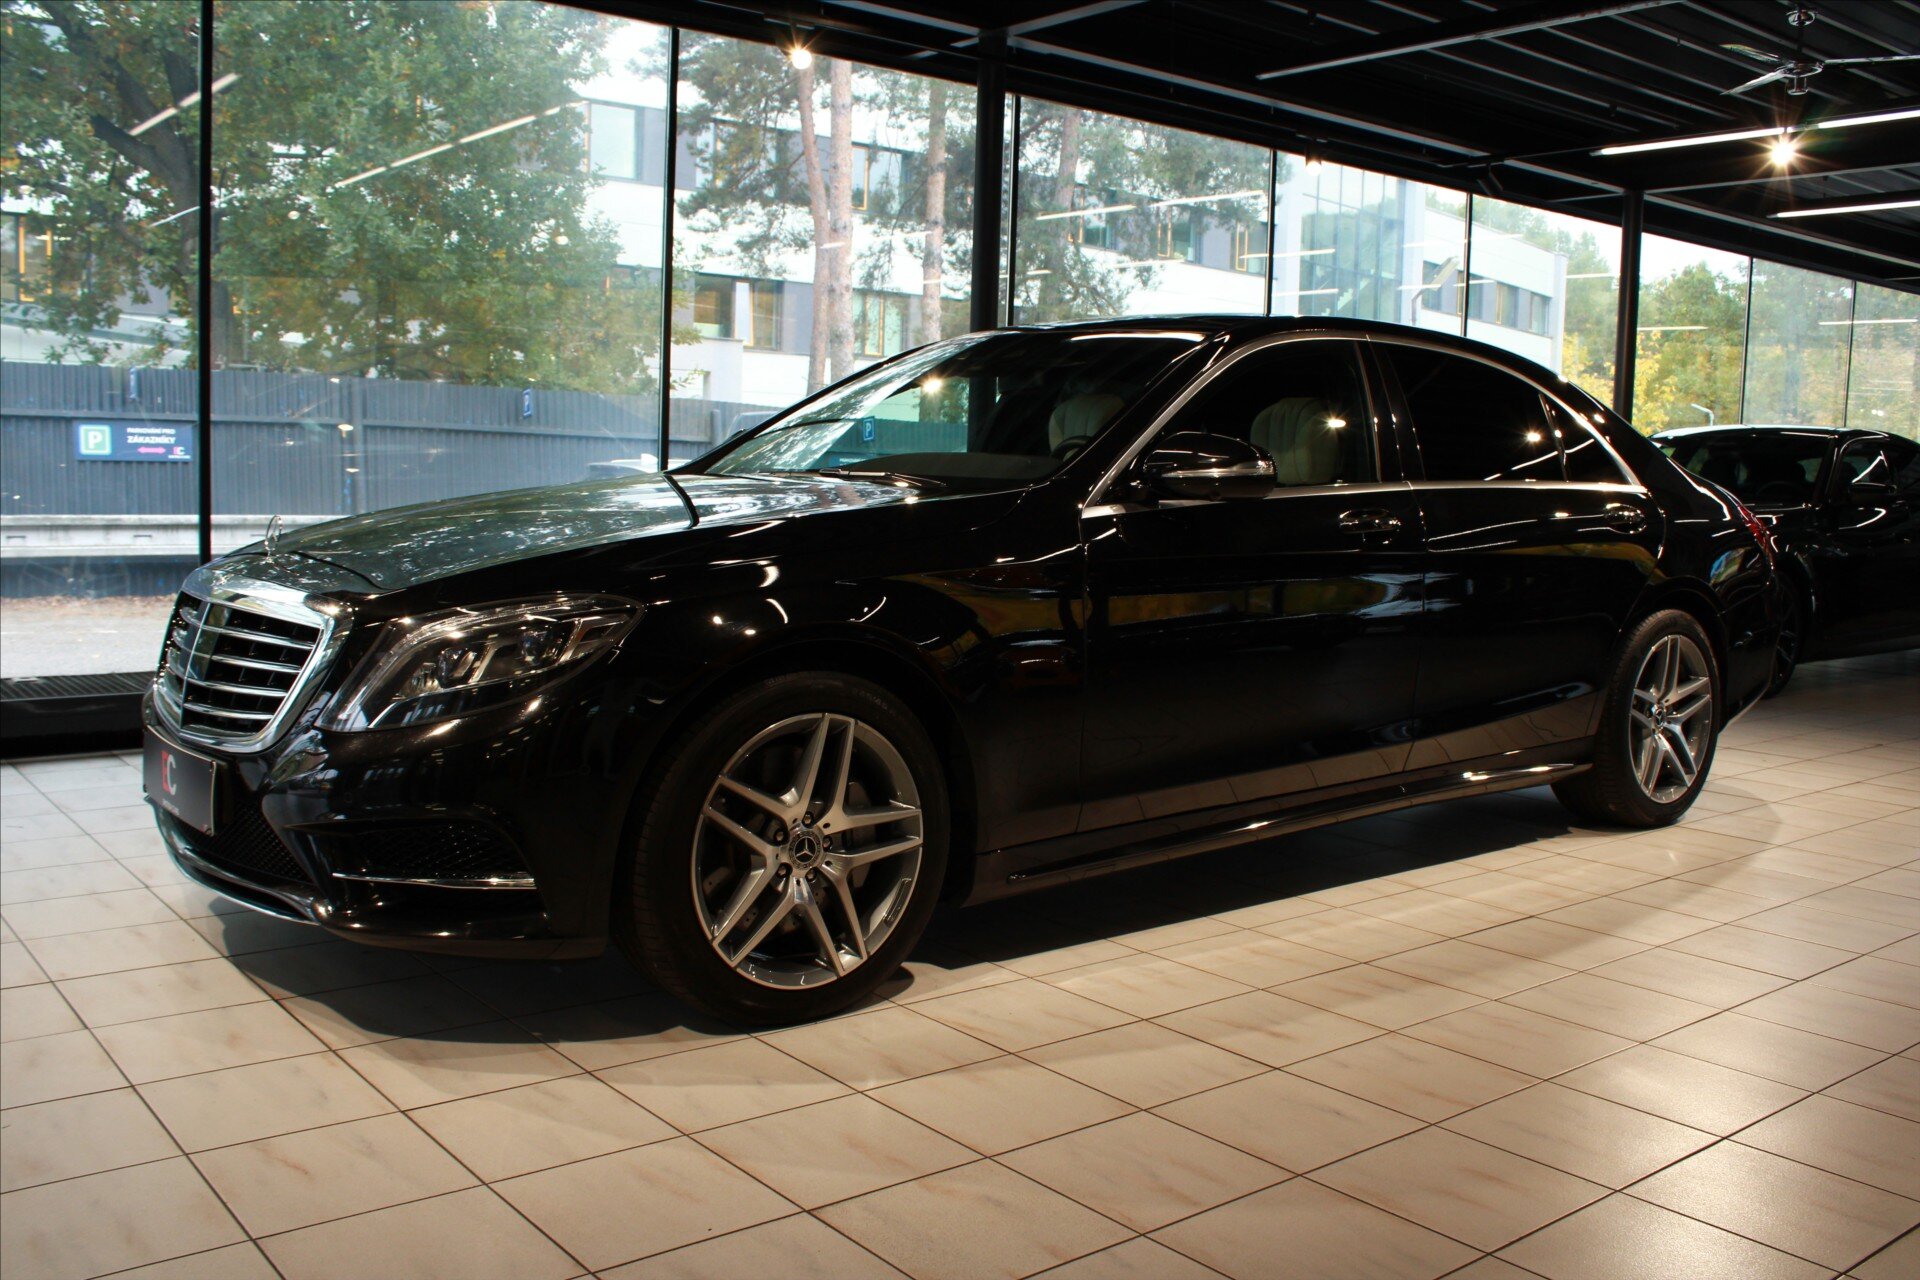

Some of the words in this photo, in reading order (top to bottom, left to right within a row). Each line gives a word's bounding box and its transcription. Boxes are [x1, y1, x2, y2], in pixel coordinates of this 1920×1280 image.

[865, 422, 872, 437] P
[88, 431, 103, 449] P
[127, 435, 176, 444] ZÁKAZNÍKY
